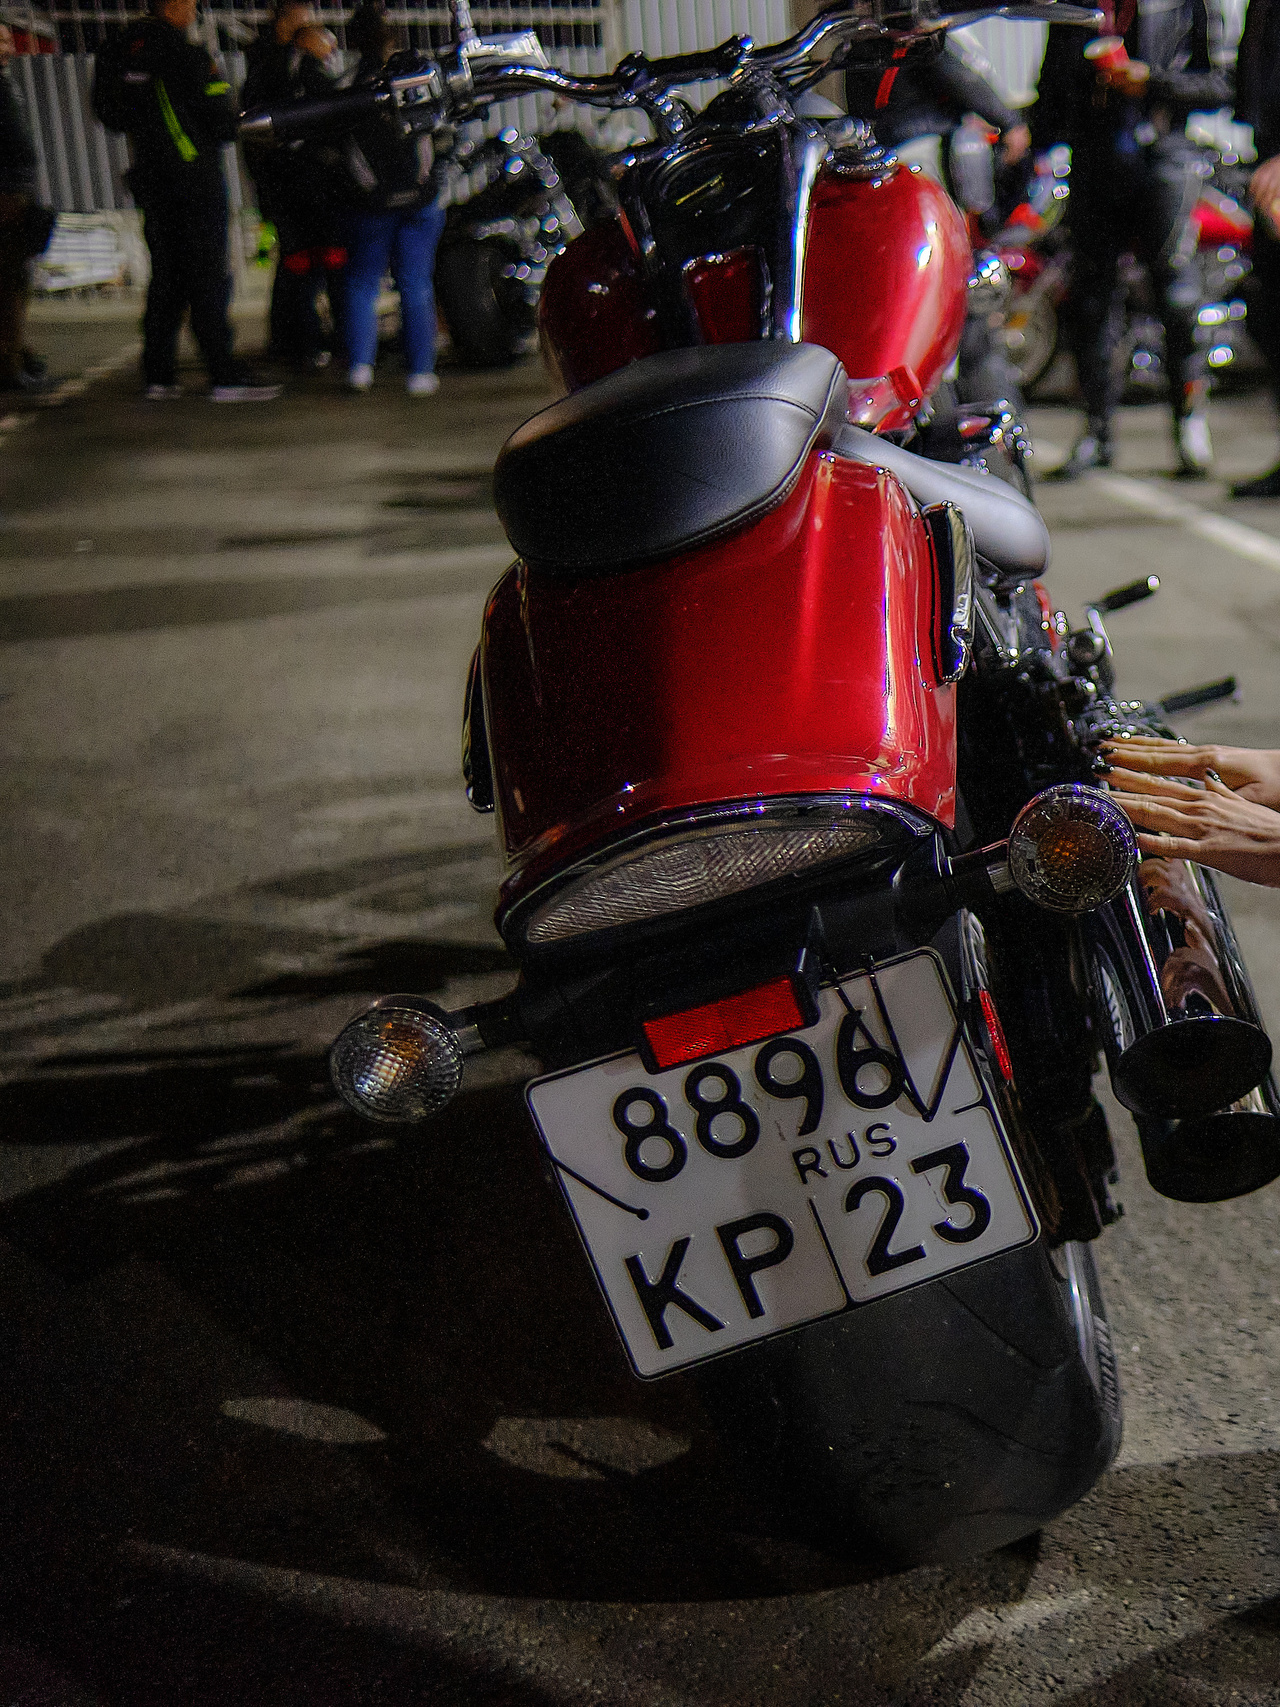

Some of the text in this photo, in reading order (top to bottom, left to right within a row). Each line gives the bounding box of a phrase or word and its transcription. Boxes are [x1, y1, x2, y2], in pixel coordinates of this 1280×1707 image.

[613, 1010, 904, 1182] 8896
[792, 1122, 898, 1184] RUS
[844, 1142, 992, 1277] 23
